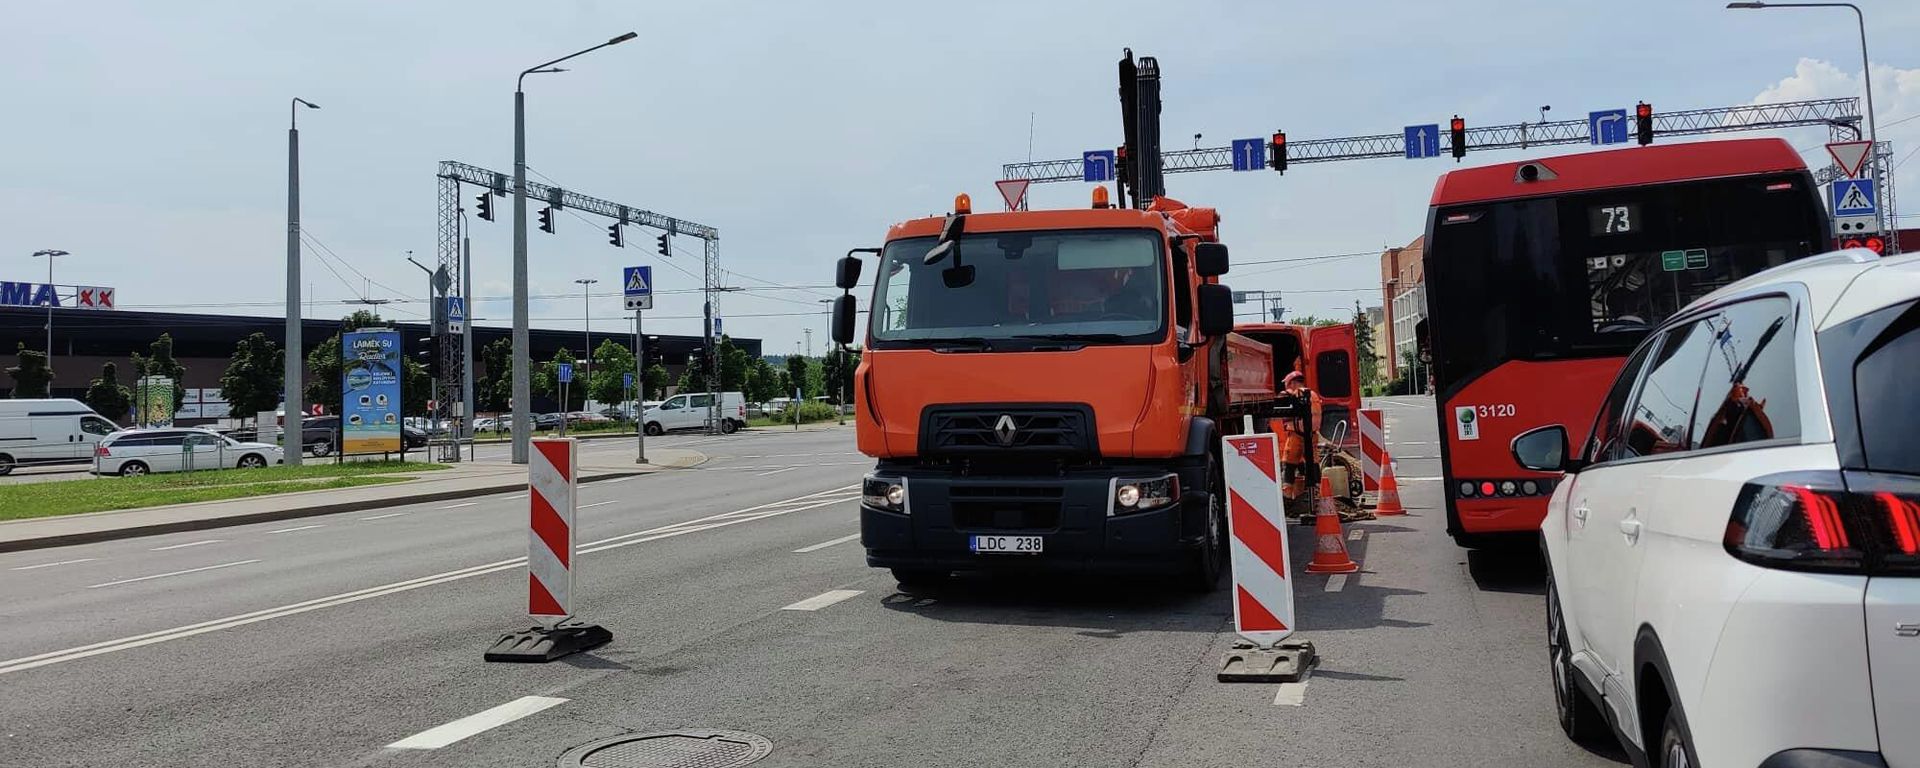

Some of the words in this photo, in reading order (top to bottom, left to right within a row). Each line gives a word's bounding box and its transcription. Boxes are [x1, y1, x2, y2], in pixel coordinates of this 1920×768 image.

[1601, 206, 1630, 233] 73
[1479, 404, 1516, 418] 3120
[977, 537, 1007, 550] LDC
[1016, 537, 1042, 551] 238
